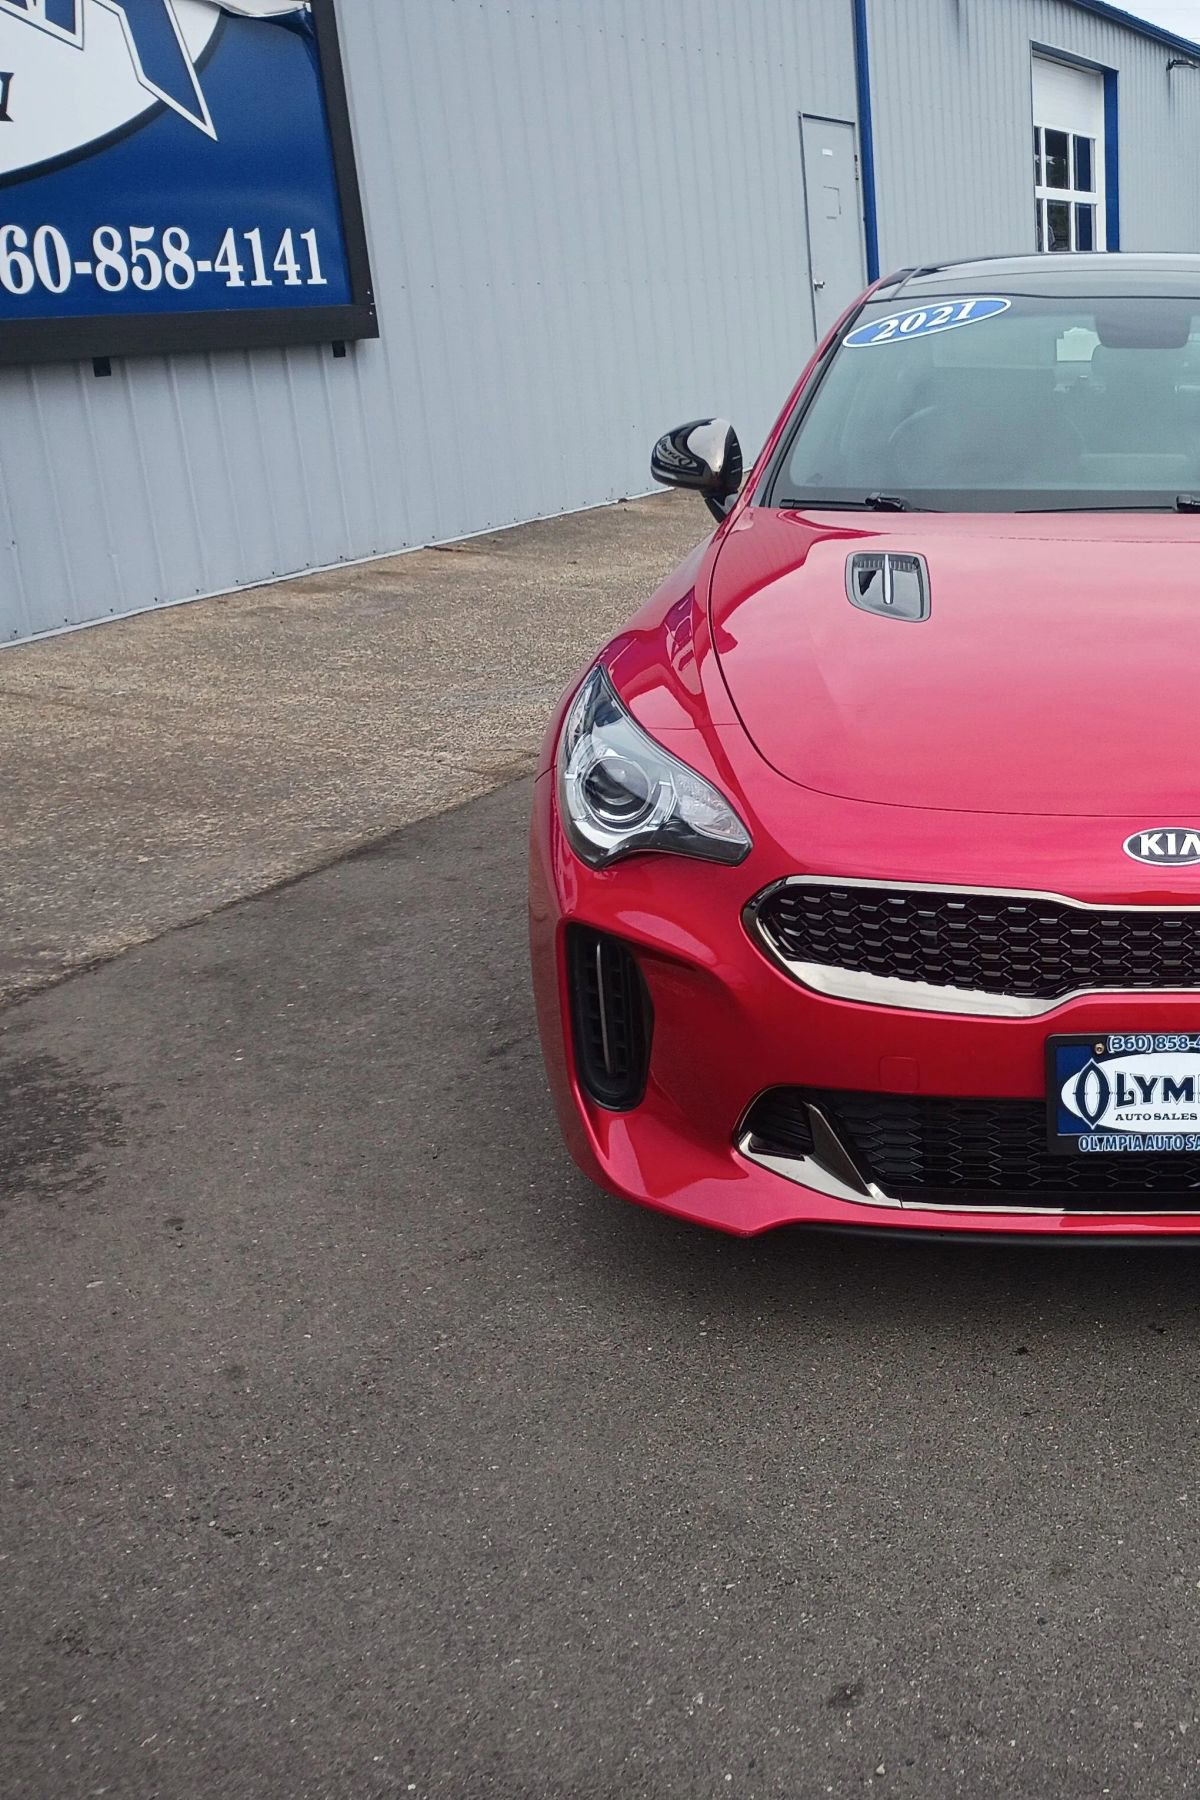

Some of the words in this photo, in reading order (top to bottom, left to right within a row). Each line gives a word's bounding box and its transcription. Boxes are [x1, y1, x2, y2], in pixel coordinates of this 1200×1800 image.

[871, 300, 977, 342] 2021
[1107, 1035, 1154, 1053] (360)
[1115, 1113, 1152, 1121] AUTO
[1153, 1112, 1198, 1121] SALES
[1078, 1135, 1144, 1152] OLYMPIA
[1145, 1134, 1184, 1151] AUTO
